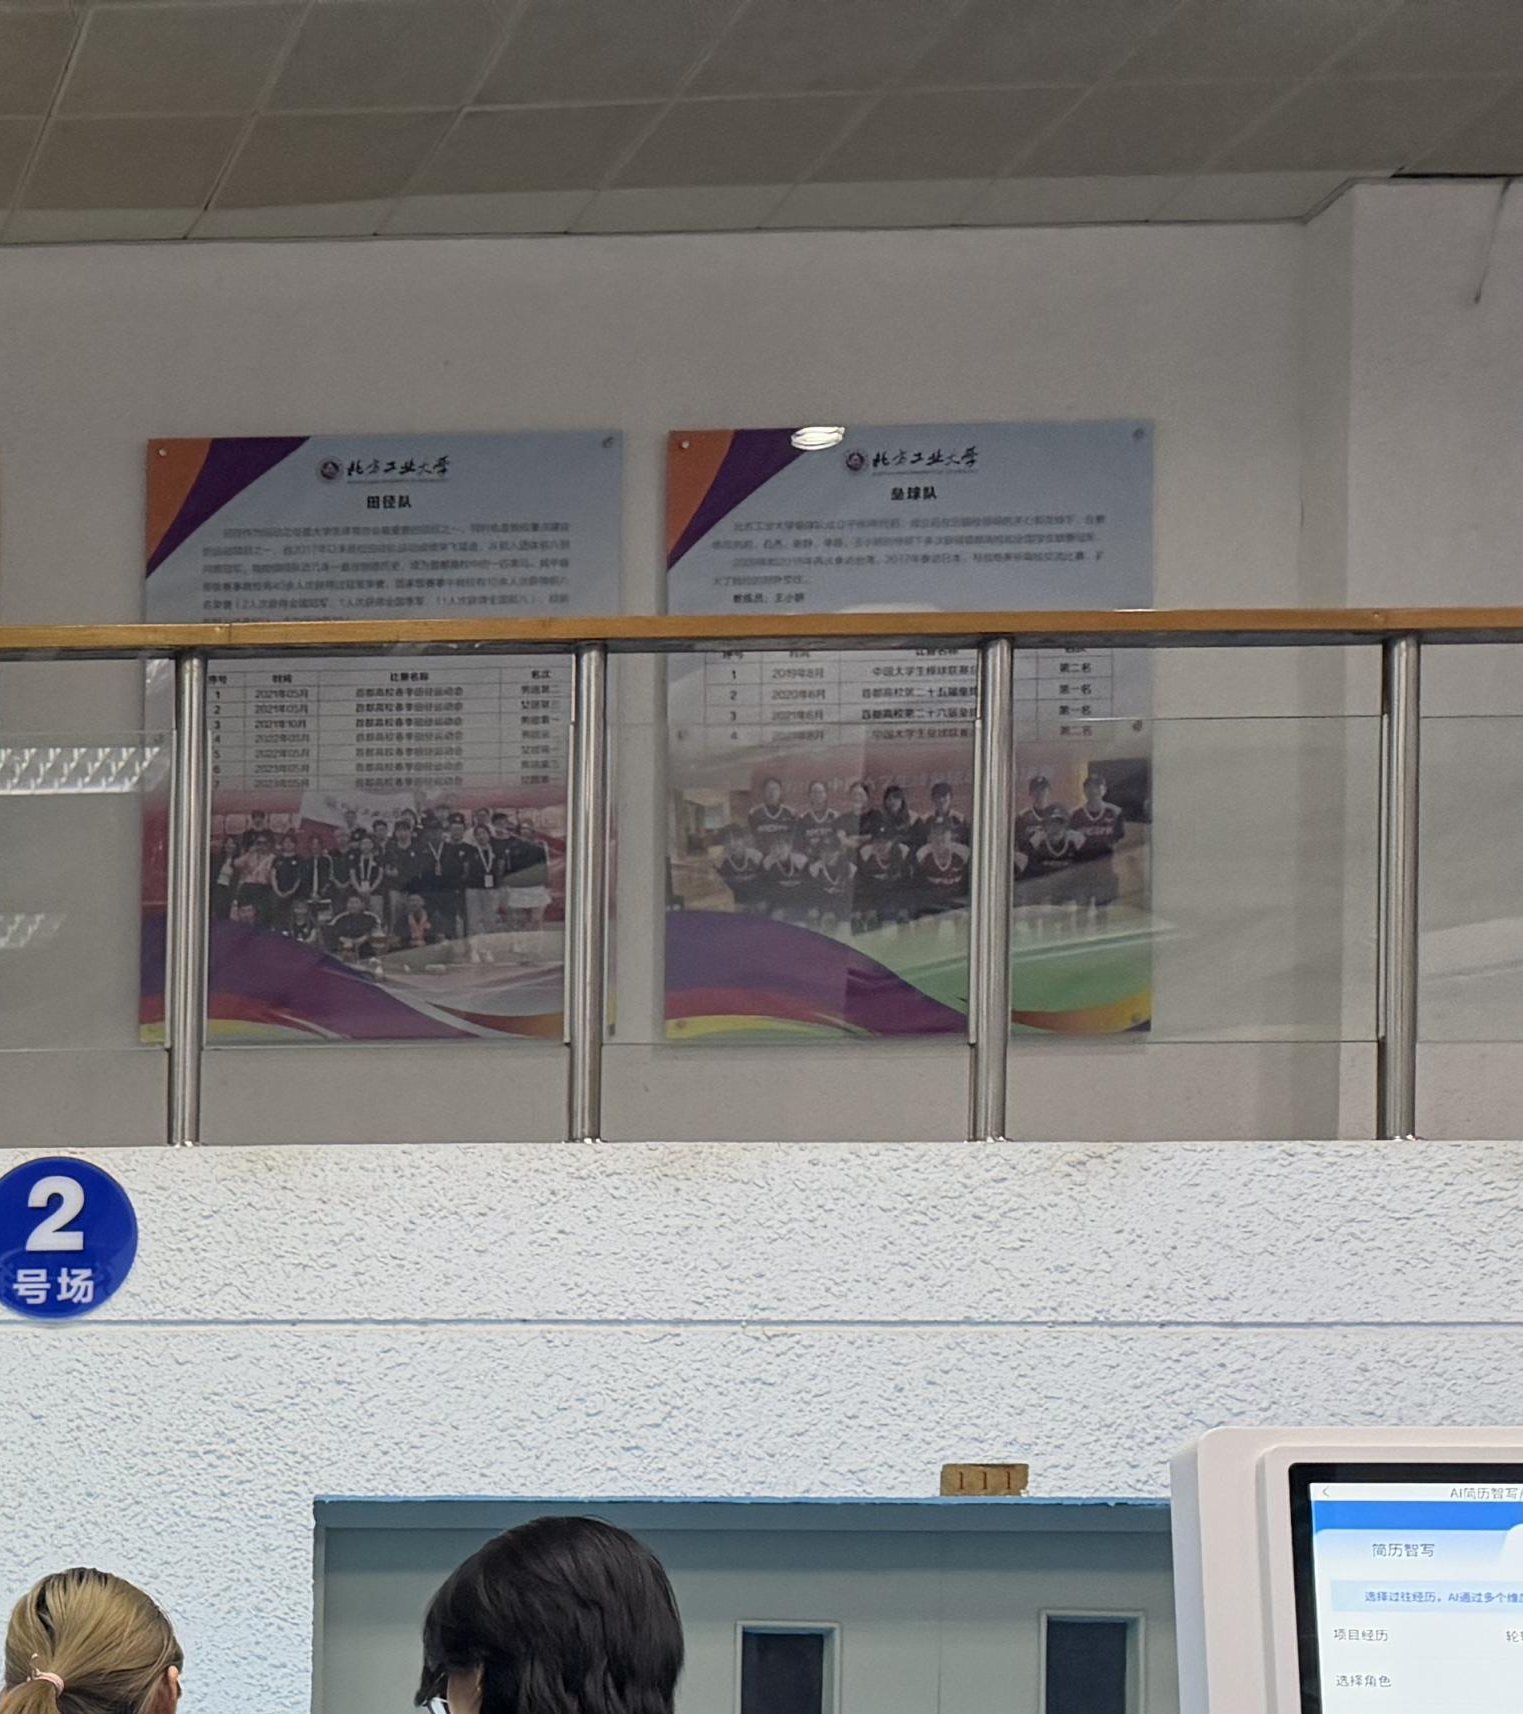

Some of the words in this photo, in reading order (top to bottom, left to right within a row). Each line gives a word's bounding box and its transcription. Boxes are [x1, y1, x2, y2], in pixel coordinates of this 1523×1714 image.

[873, 446, 979, 468] 北方工业大学
[347, 455, 450, 478] 北方工业大学
[891, 486, 937, 501] 垒球队
[367, 495, 412, 509] 田径队
[26, 1176, 85, 1251] 2
[13, 1268, 94, 1304] 号场
[1372, 1543, 1434, 1557] 简历智写
[1333, 1628, 1388, 1642] 项目经历
[1336, 1675, 1392, 1688] 选择角色
